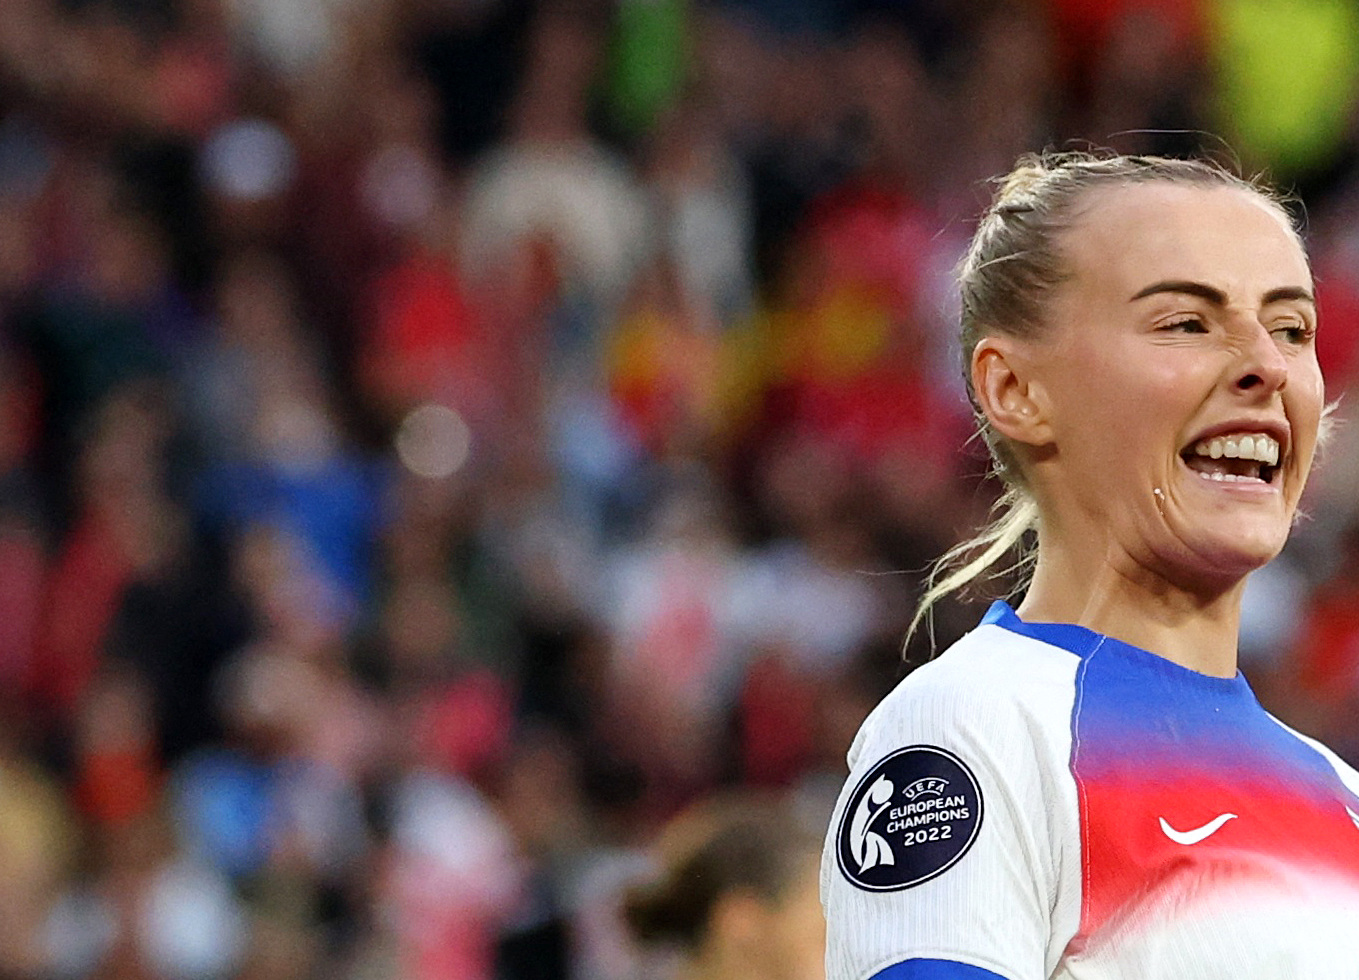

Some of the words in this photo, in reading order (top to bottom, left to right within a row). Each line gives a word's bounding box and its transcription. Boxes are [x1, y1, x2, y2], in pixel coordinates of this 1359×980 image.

[905, 780, 945, 798] UEFA
[889, 795, 965, 820] EUROPEAN
[886, 808, 970, 833] CHAMPIONS
[904, 825, 952, 847] 2022
